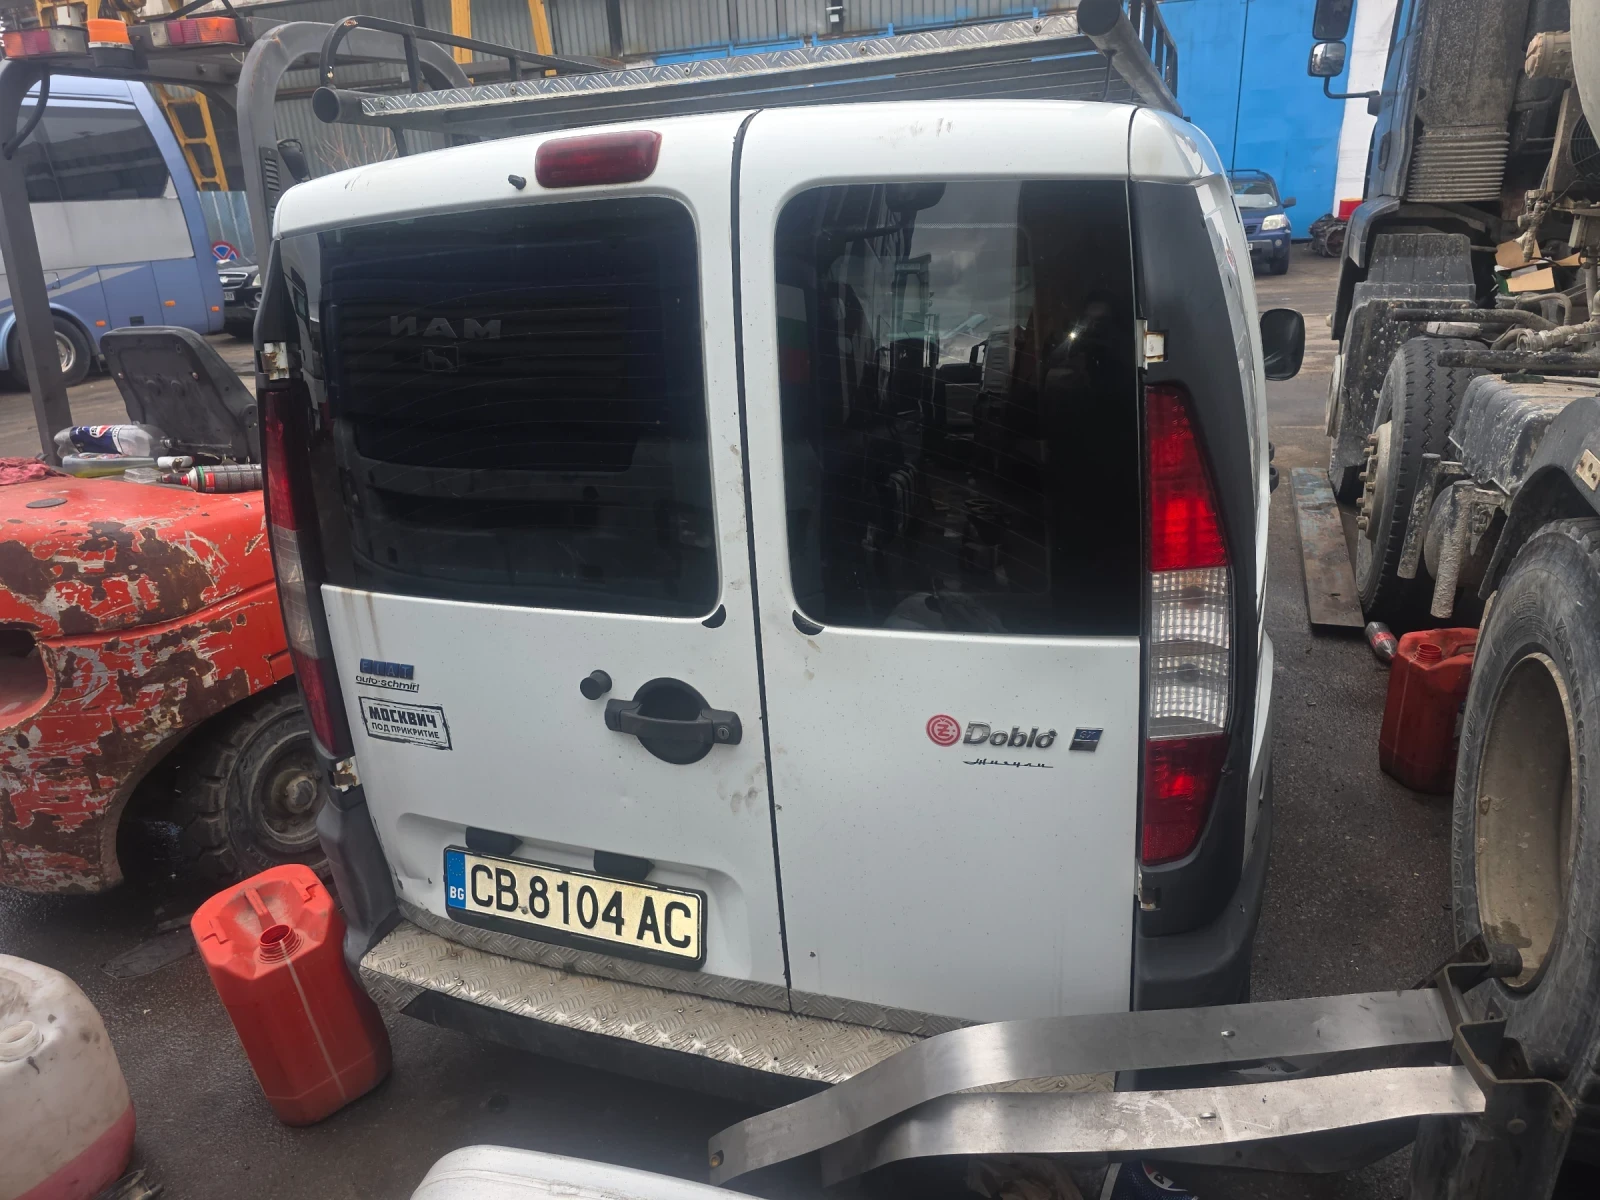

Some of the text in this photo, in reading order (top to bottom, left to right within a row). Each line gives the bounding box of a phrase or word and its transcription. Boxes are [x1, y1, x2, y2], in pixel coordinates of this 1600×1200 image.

[361, 660, 412, 679] FIAT
[368, 706, 437, 729] МОСКВИЧ
[371, 722, 440, 739] ПОД ПРИКРИТИЕ
[450, 886, 465, 901] BG
[470, 864, 692, 949] CB 8104 AC
